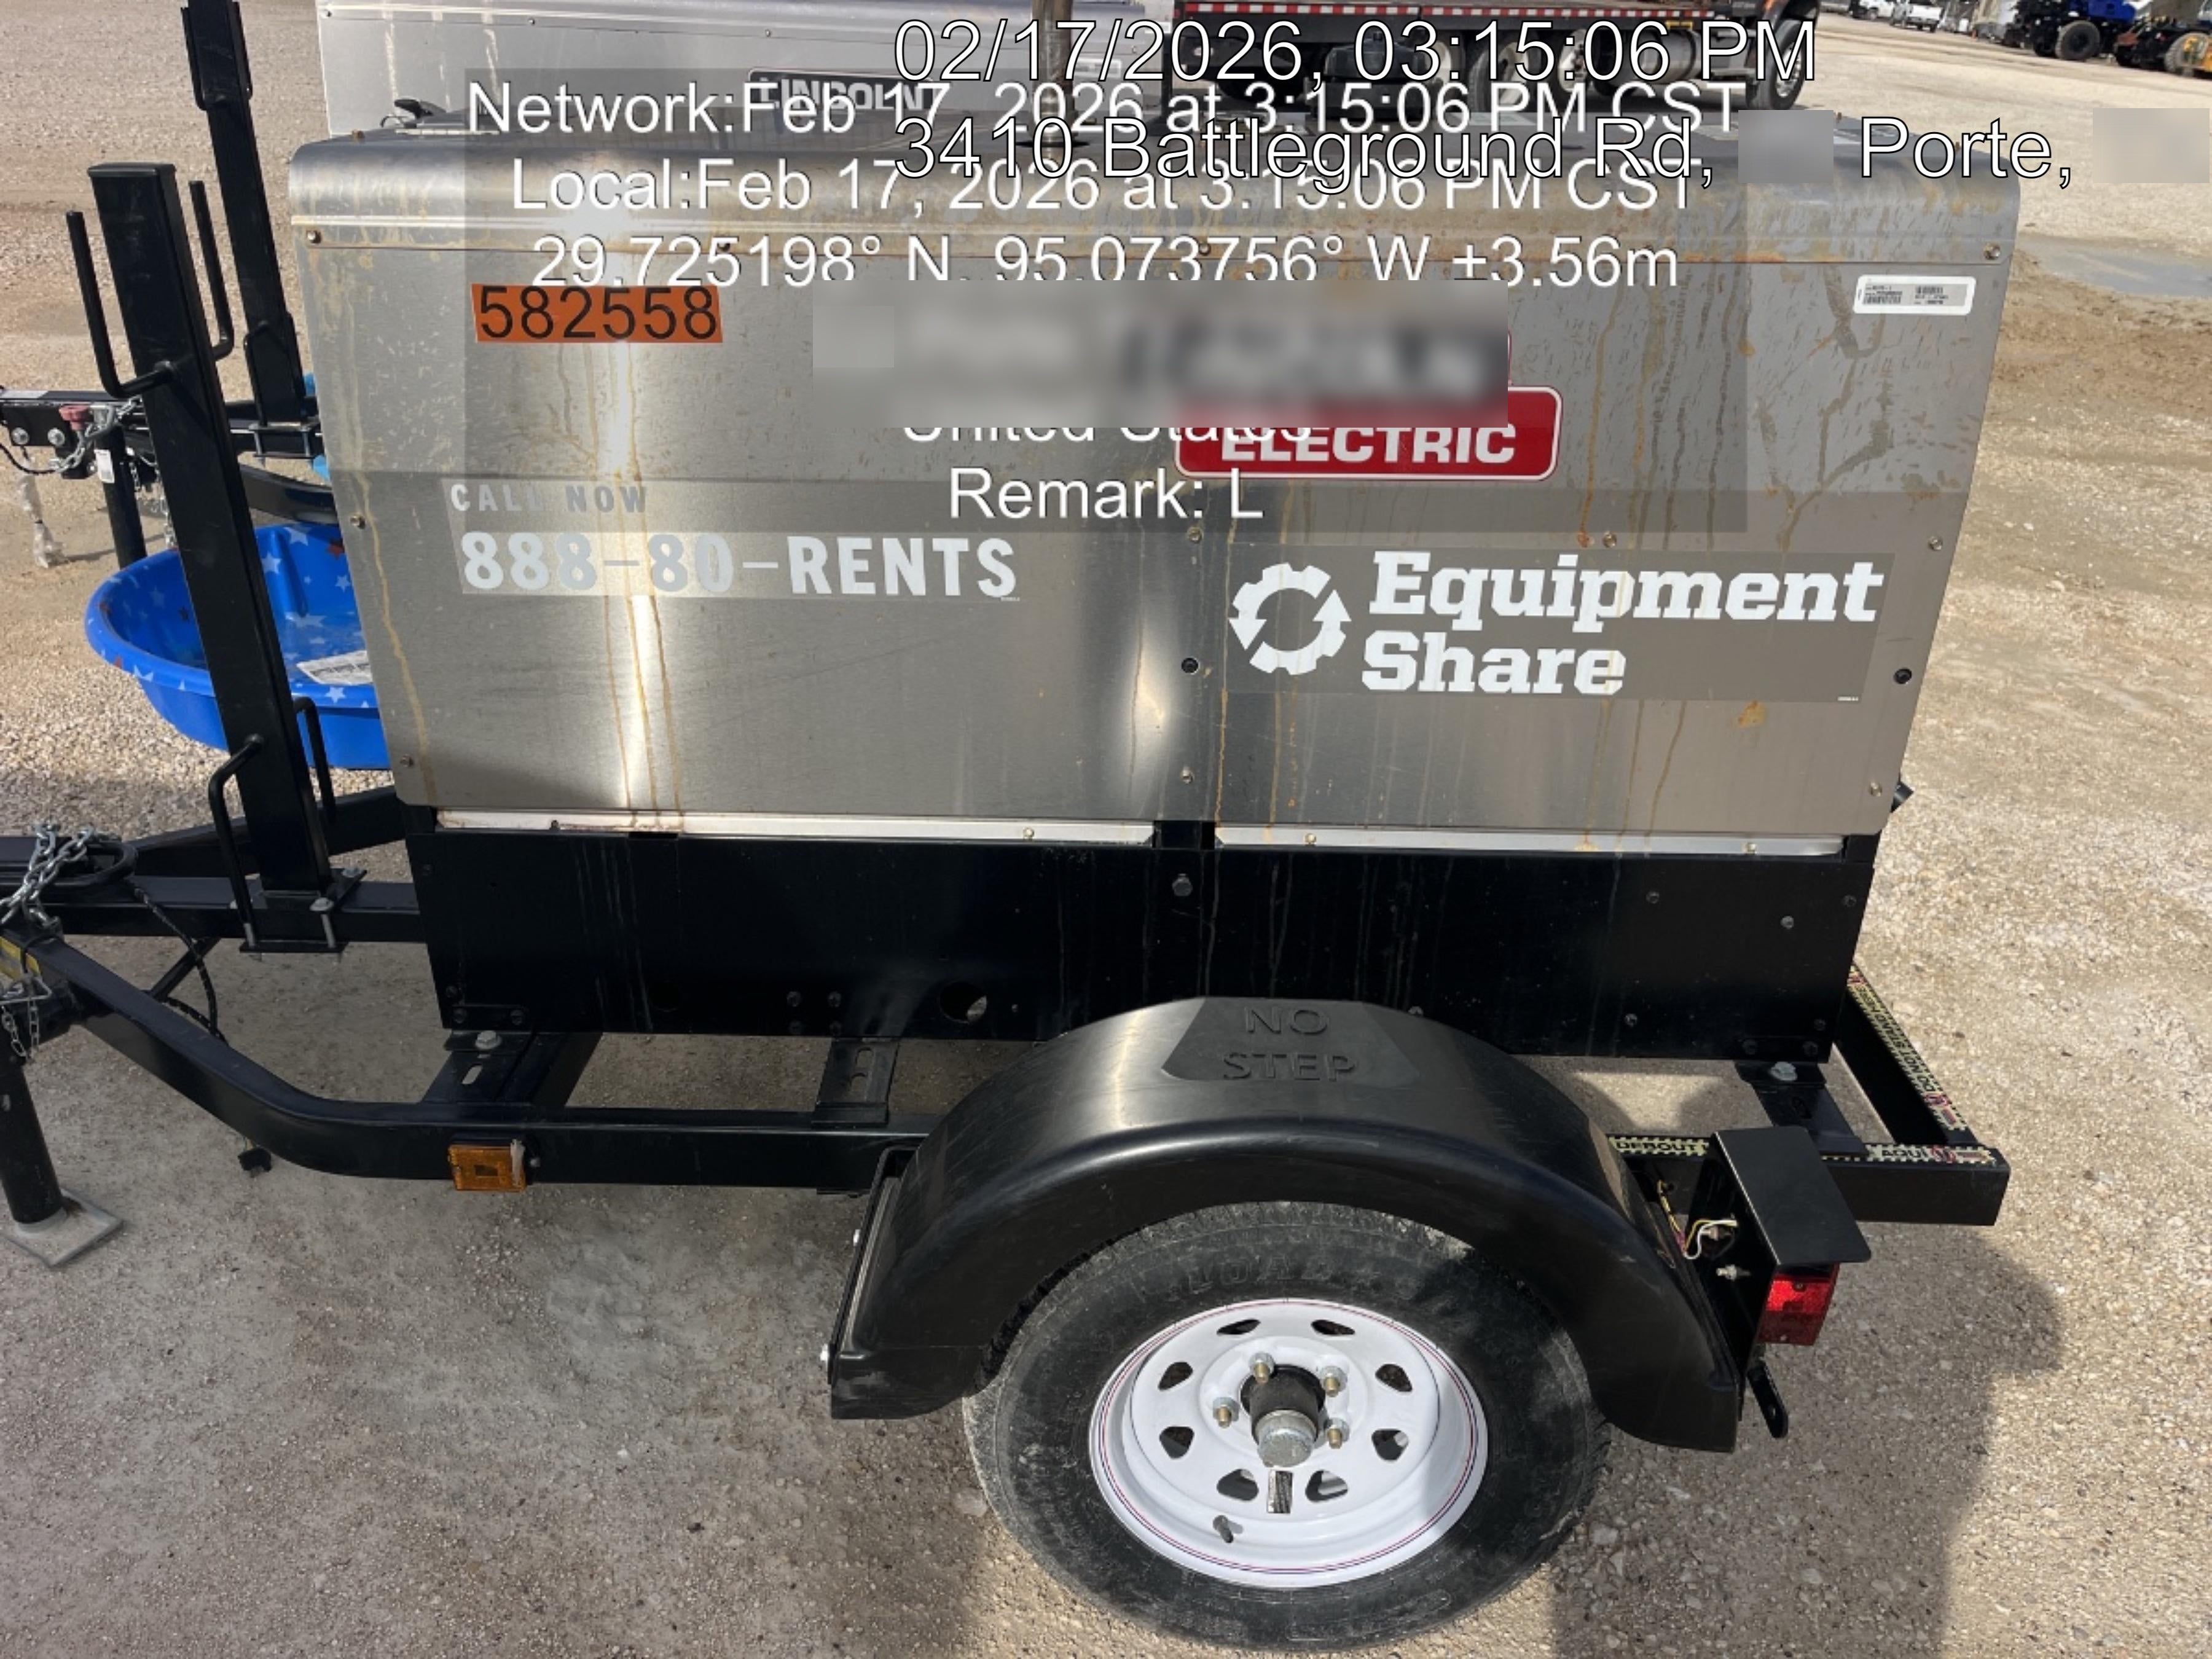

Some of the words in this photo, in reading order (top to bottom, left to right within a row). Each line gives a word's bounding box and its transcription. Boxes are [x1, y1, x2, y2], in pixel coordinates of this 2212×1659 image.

[480, 286, 718, 339] 582558
[1222, 423, 1516, 463] ELECTRIC
[450, 484, 545, 512] CALL
[564, 485, 646, 512] NOW
[461, 531, 1018, 597] 888-80-RENTS
[1369, 551, 1885, 632] Equipment
[1362, 629, 1626, 696] Share
[1244, 1005, 1329, 1035] NO
[1223, 1051, 1355, 1082] STEP
